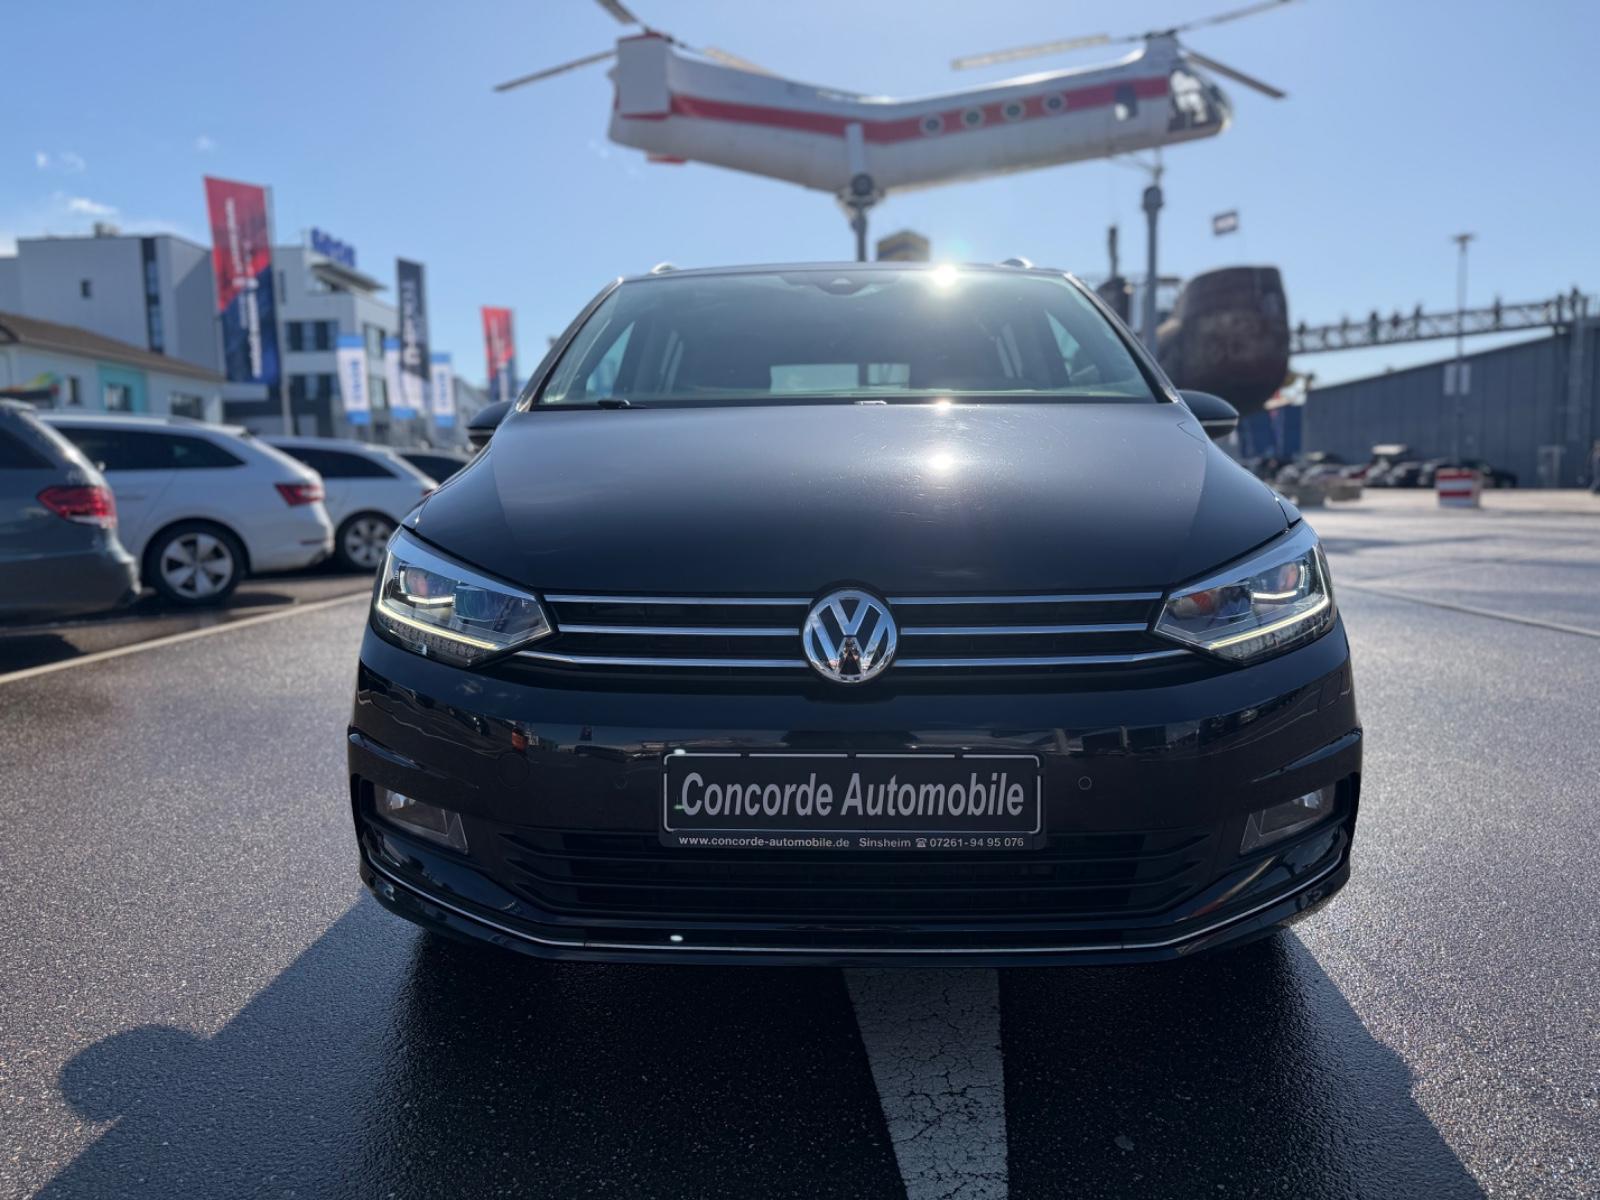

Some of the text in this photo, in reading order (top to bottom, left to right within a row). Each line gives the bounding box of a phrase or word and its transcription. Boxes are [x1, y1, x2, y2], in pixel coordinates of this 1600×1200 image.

[681, 772, 1024, 816] Concorde Automobile
[678, 836, 1024, 848] www.concorde-automobile.de Sinsheim 07261-94 95 076
